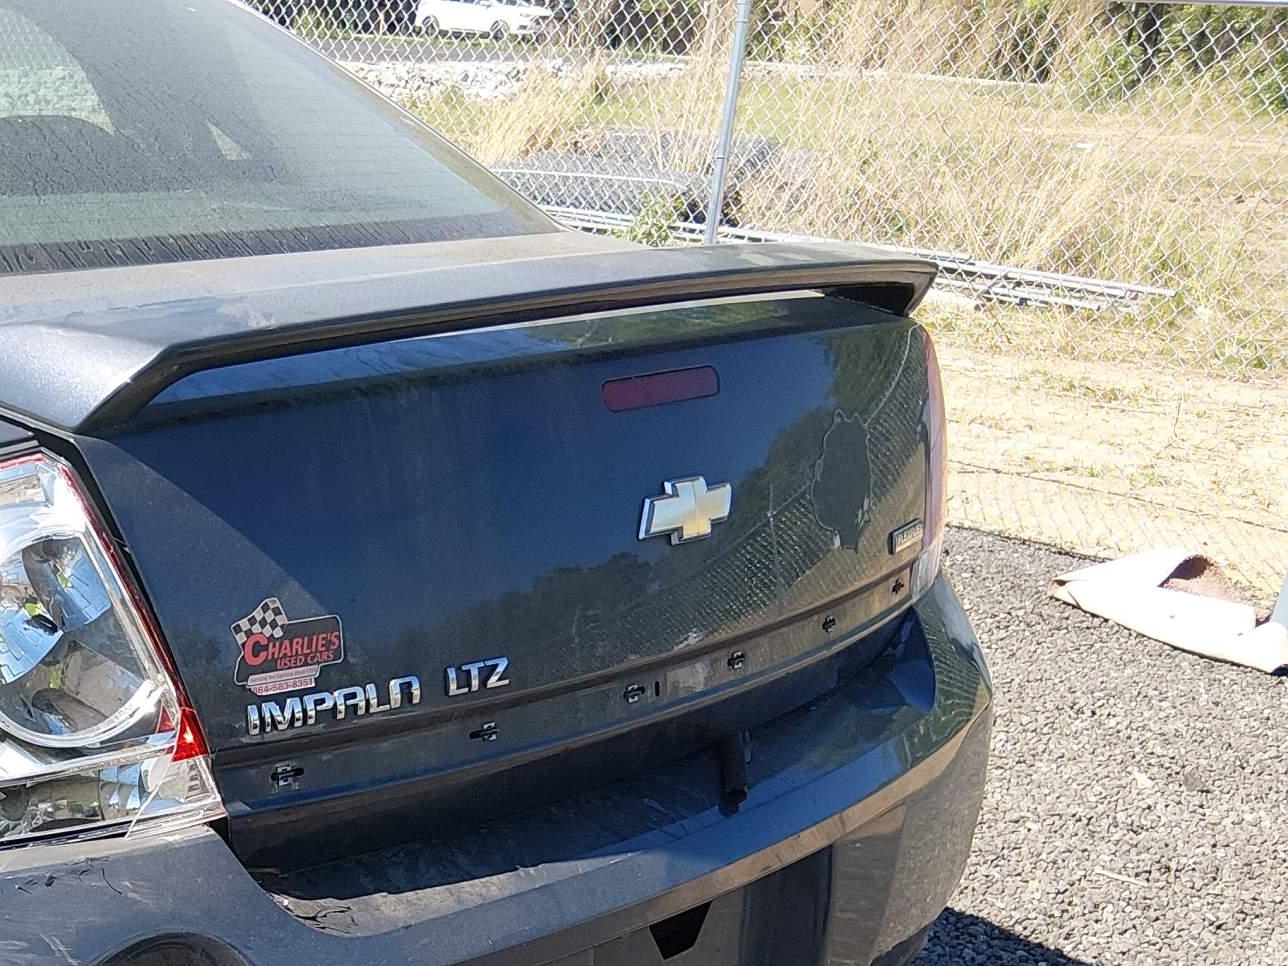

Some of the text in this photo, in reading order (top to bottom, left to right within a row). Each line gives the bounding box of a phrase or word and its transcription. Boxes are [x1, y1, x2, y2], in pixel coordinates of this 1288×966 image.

[244, 632, 340, 666] CHARLIE'S
[277, 651, 335, 669] USED CARS
[246, 656, 511, 736] IMPALA LTZ
